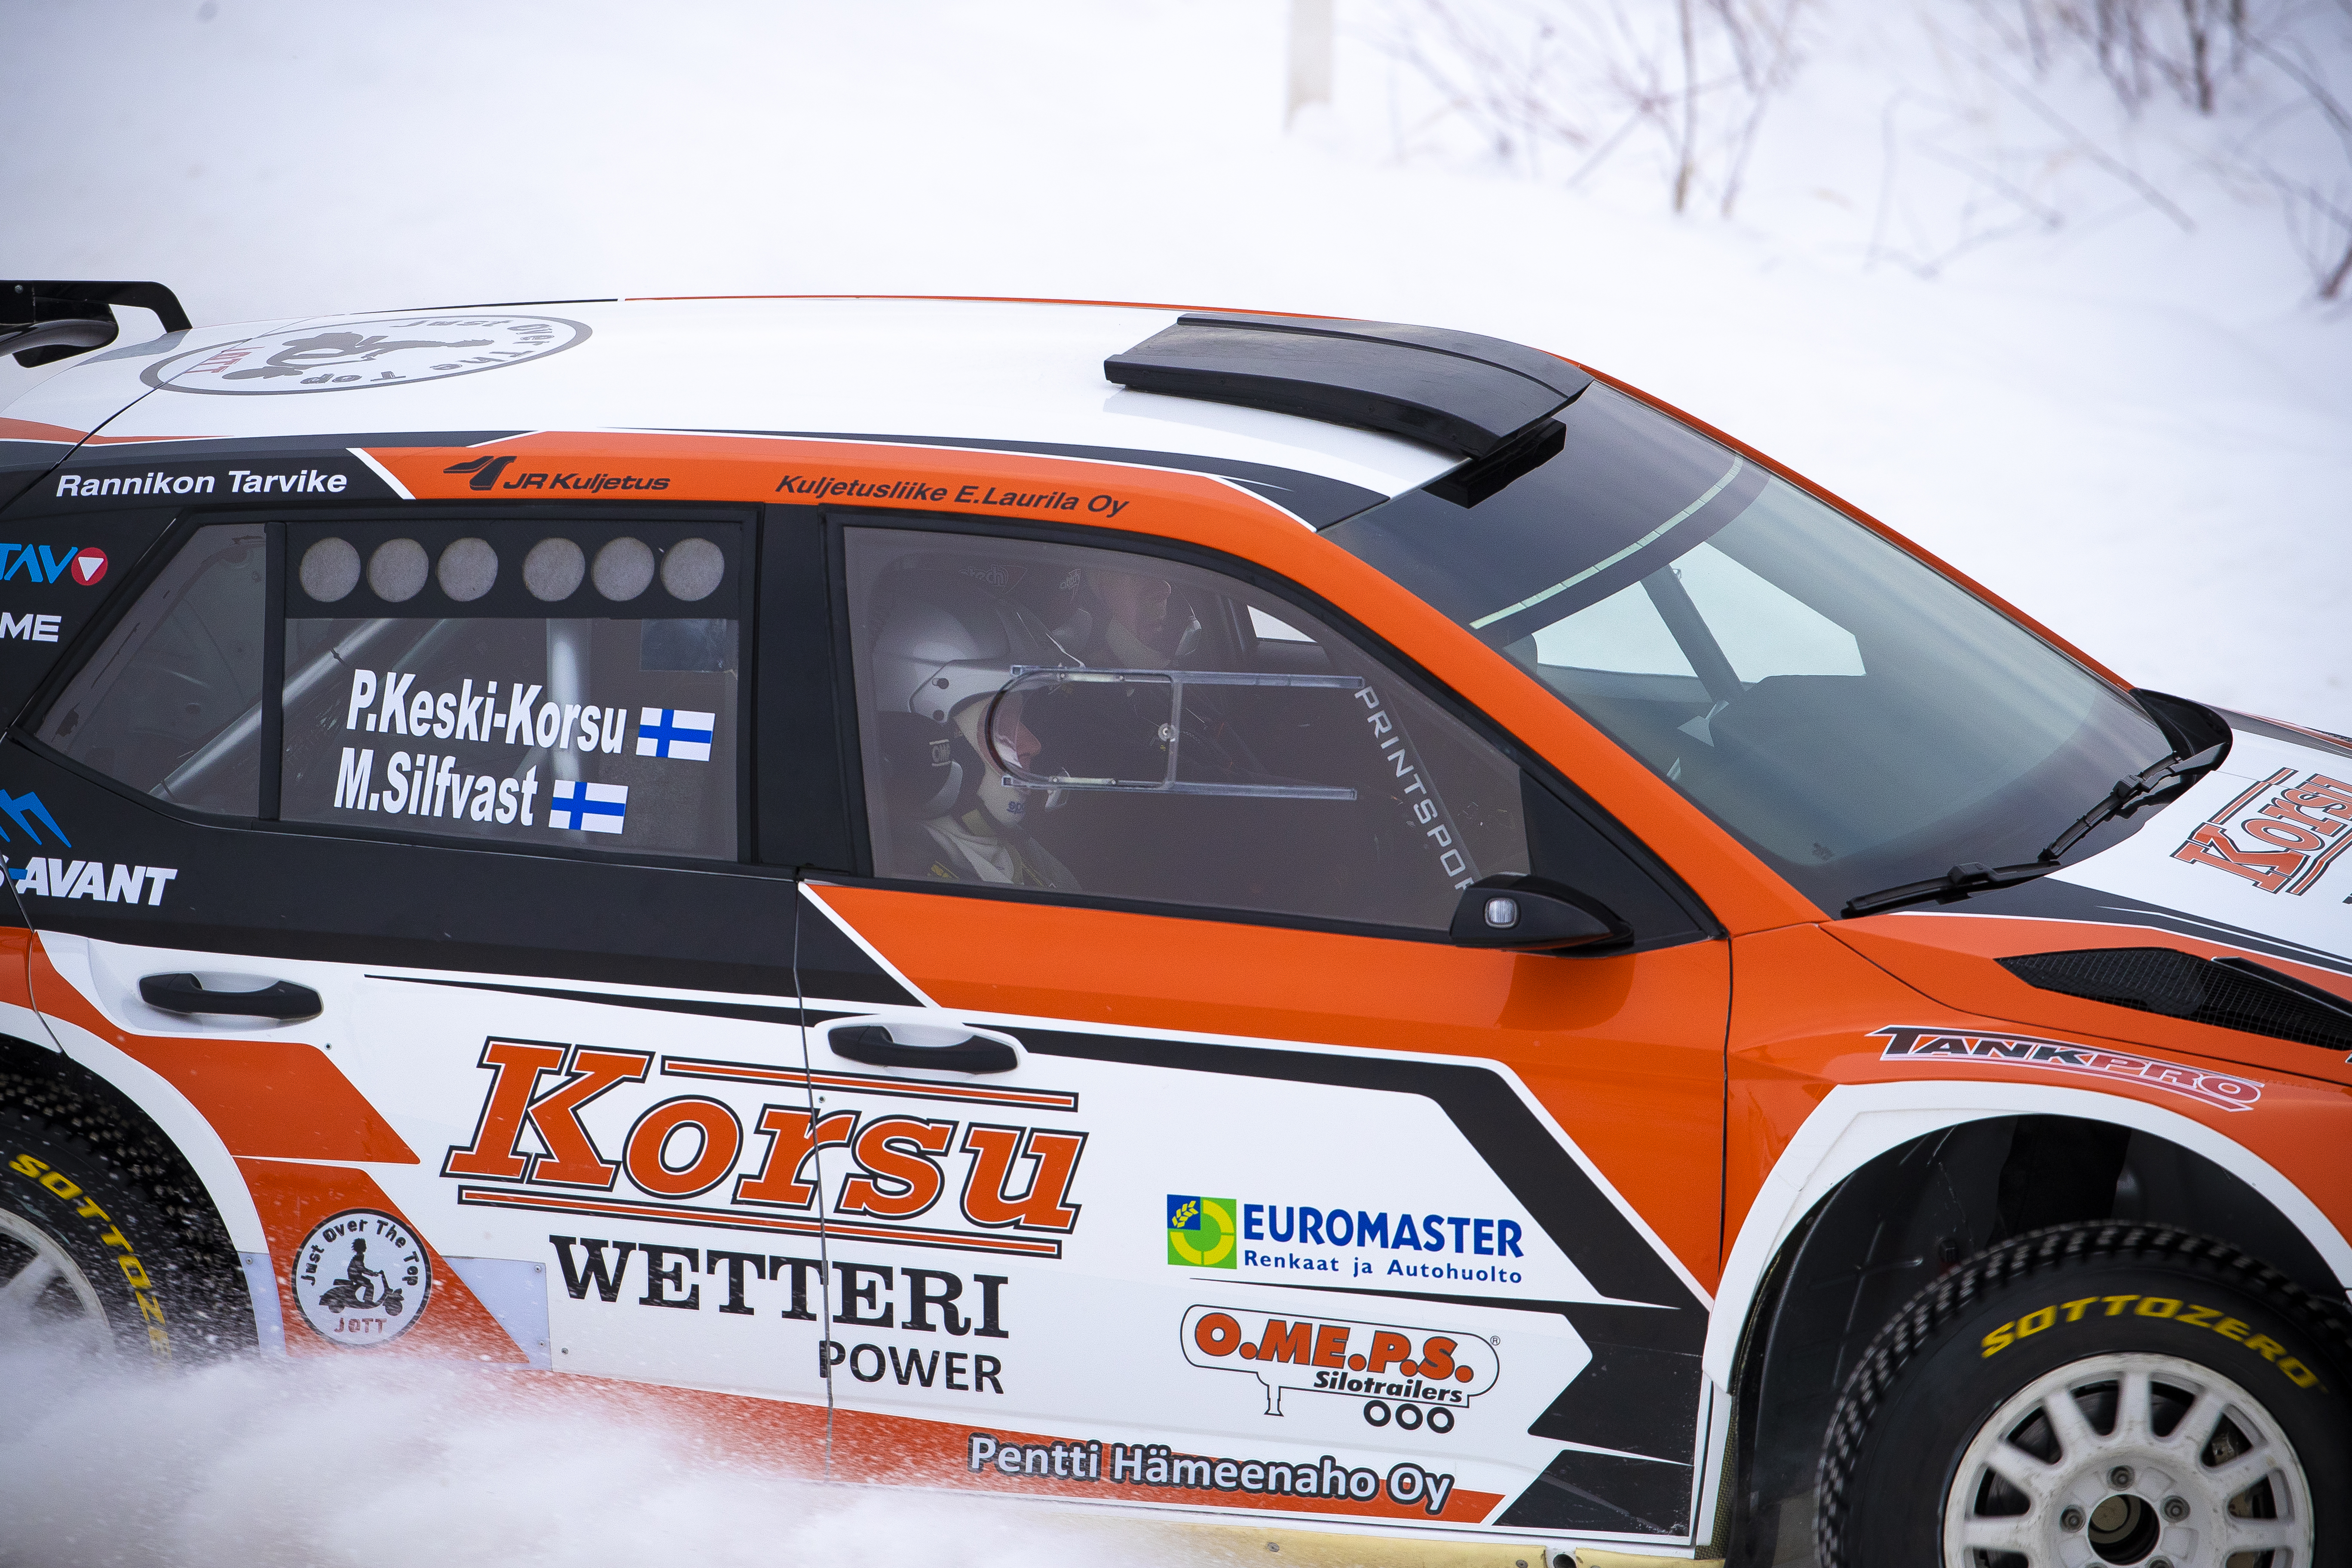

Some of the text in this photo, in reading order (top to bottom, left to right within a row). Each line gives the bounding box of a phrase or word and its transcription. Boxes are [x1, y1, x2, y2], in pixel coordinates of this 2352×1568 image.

[56, 469, 347, 496] Rannikon Tarvike
[503, 473, 671, 493] JR Kuljetus
[775, 475, 1130, 518] Kuljetusliike E.Laurila Oy
[346, 668, 627, 754] P.Keski-Korsu
[333, 747, 538, 827] M.Silfvast
[1865, 1025, 2264, 1105] TANKPRO
[439, 1035, 1090, 1234] Korsu
[301, 1219, 420, 1286] Just Over The Top
[1243, 1204, 1524, 1259] EUROMASTER
[548, 1234, 1009, 1339] WETTERI
[1244, 1250, 1522, 1283] Renkaat ja Autohuolto
[819, 1339, 1004, 1395] POWER
[1981, 1294, 2324, 1389] SOTTOZERO
[1313, 1370, 1463, 1403] Silotrailers
[969, 1435, 1455, 1512] Pentti Hämeenaho Oy
